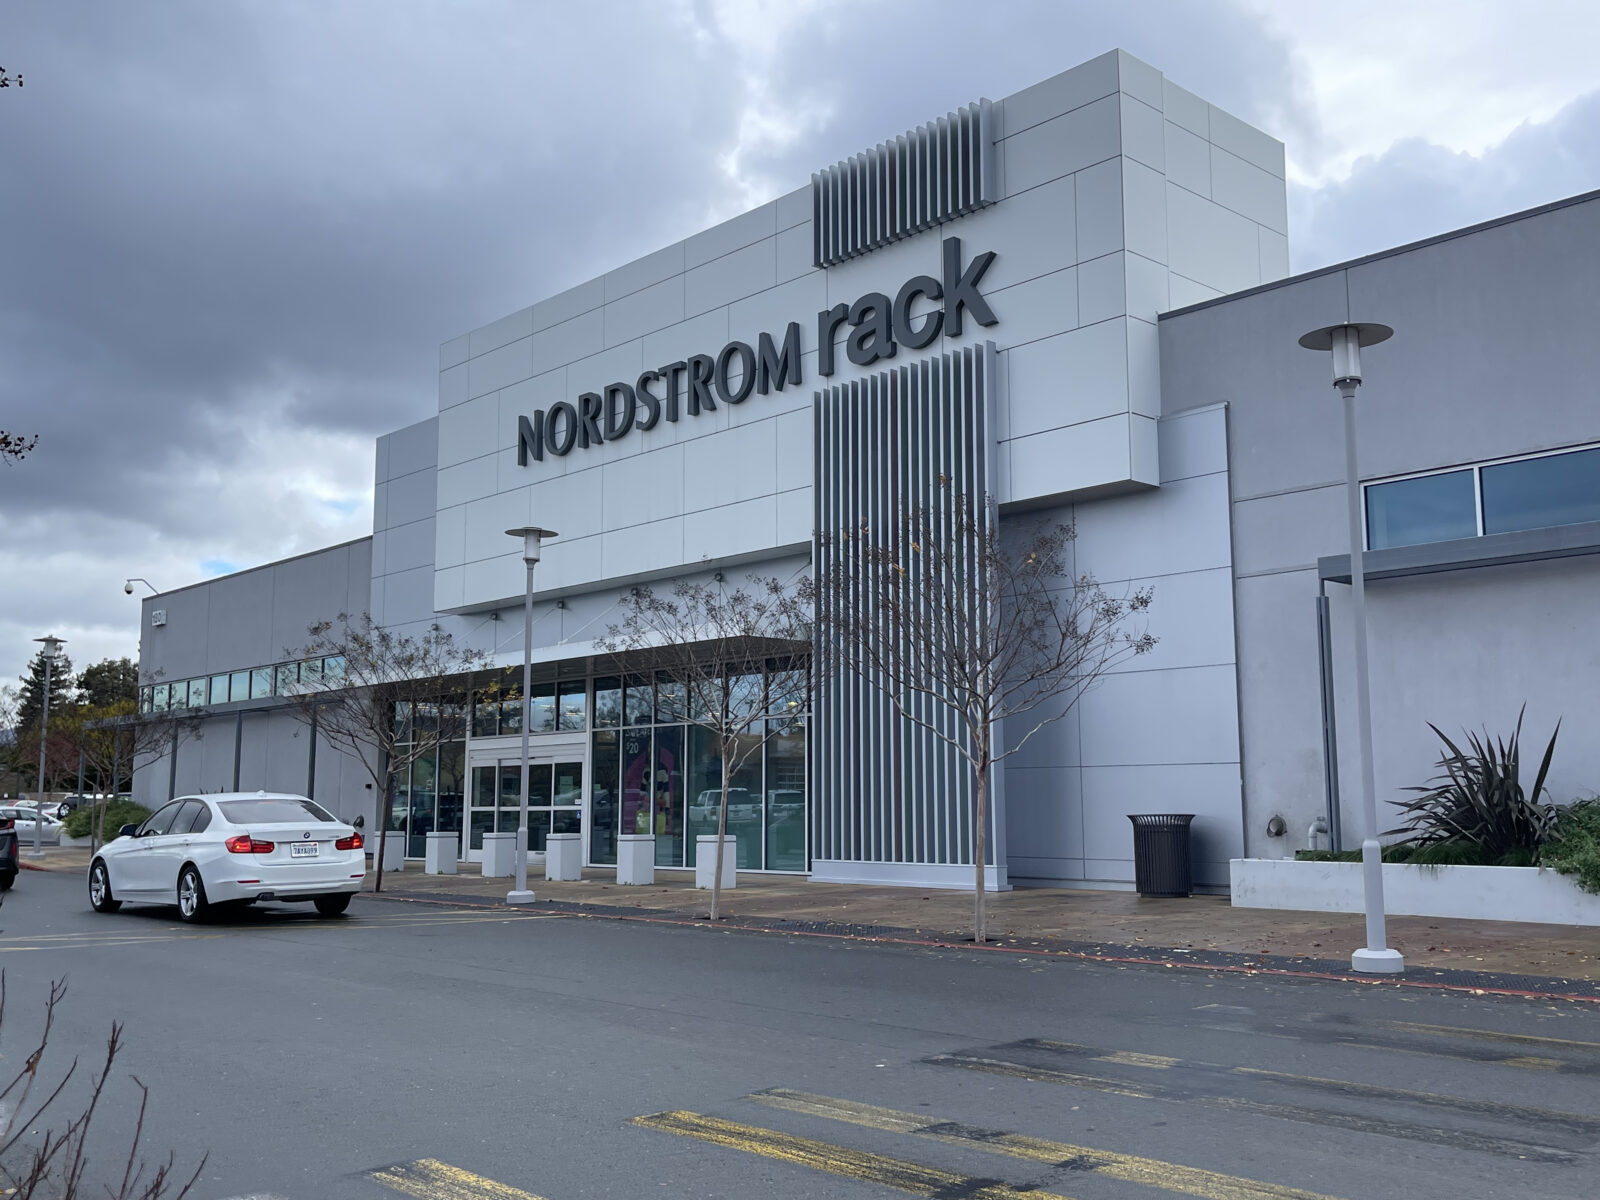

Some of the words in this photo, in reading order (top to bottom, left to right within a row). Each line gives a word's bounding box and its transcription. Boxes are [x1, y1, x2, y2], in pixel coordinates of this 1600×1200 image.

[517, 321, 801, 467] NORDSTROM
[818, 236, 999, 377] rack
[626, 742, 639, 754] $20
